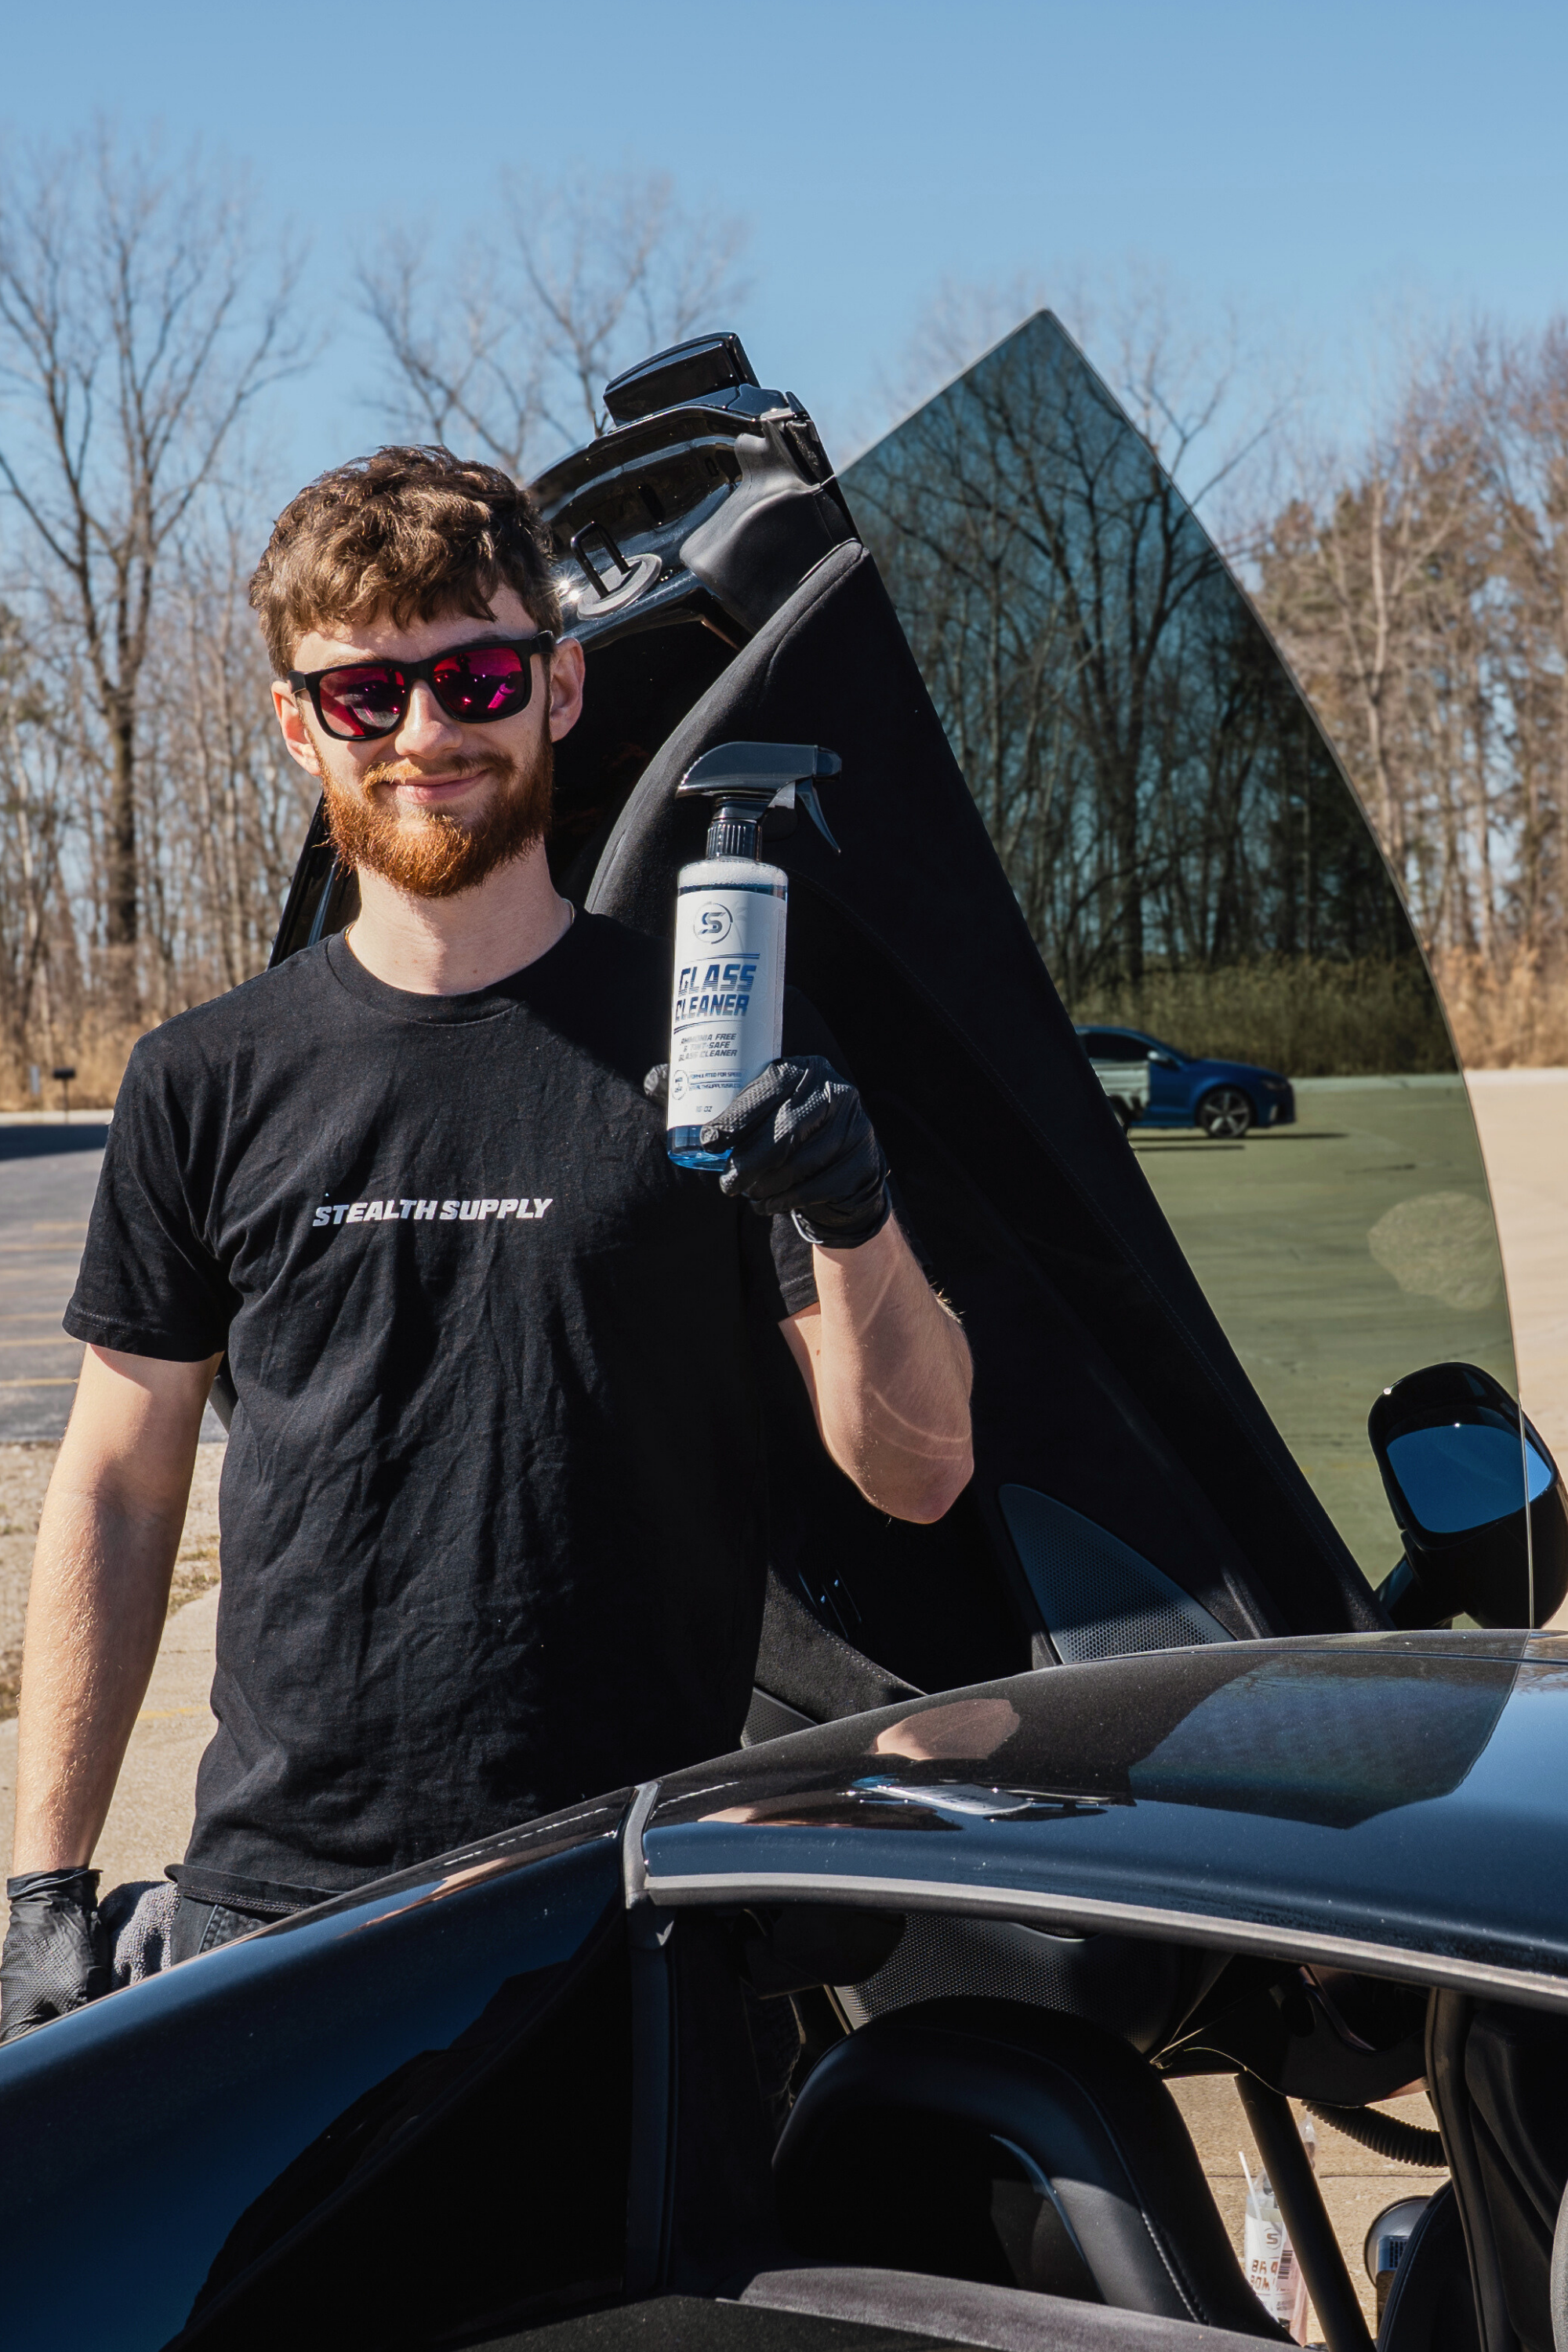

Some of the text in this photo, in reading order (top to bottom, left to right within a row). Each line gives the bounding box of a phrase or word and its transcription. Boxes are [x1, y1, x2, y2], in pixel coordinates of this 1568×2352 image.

[678, 964, 757, 997] GLASS
[675, 993, 750, 1022] CLEANER
[699, 1049, 738, 1058] CLEANER
[312, 1198, 554, 1227] STEALTH SUPPLY
